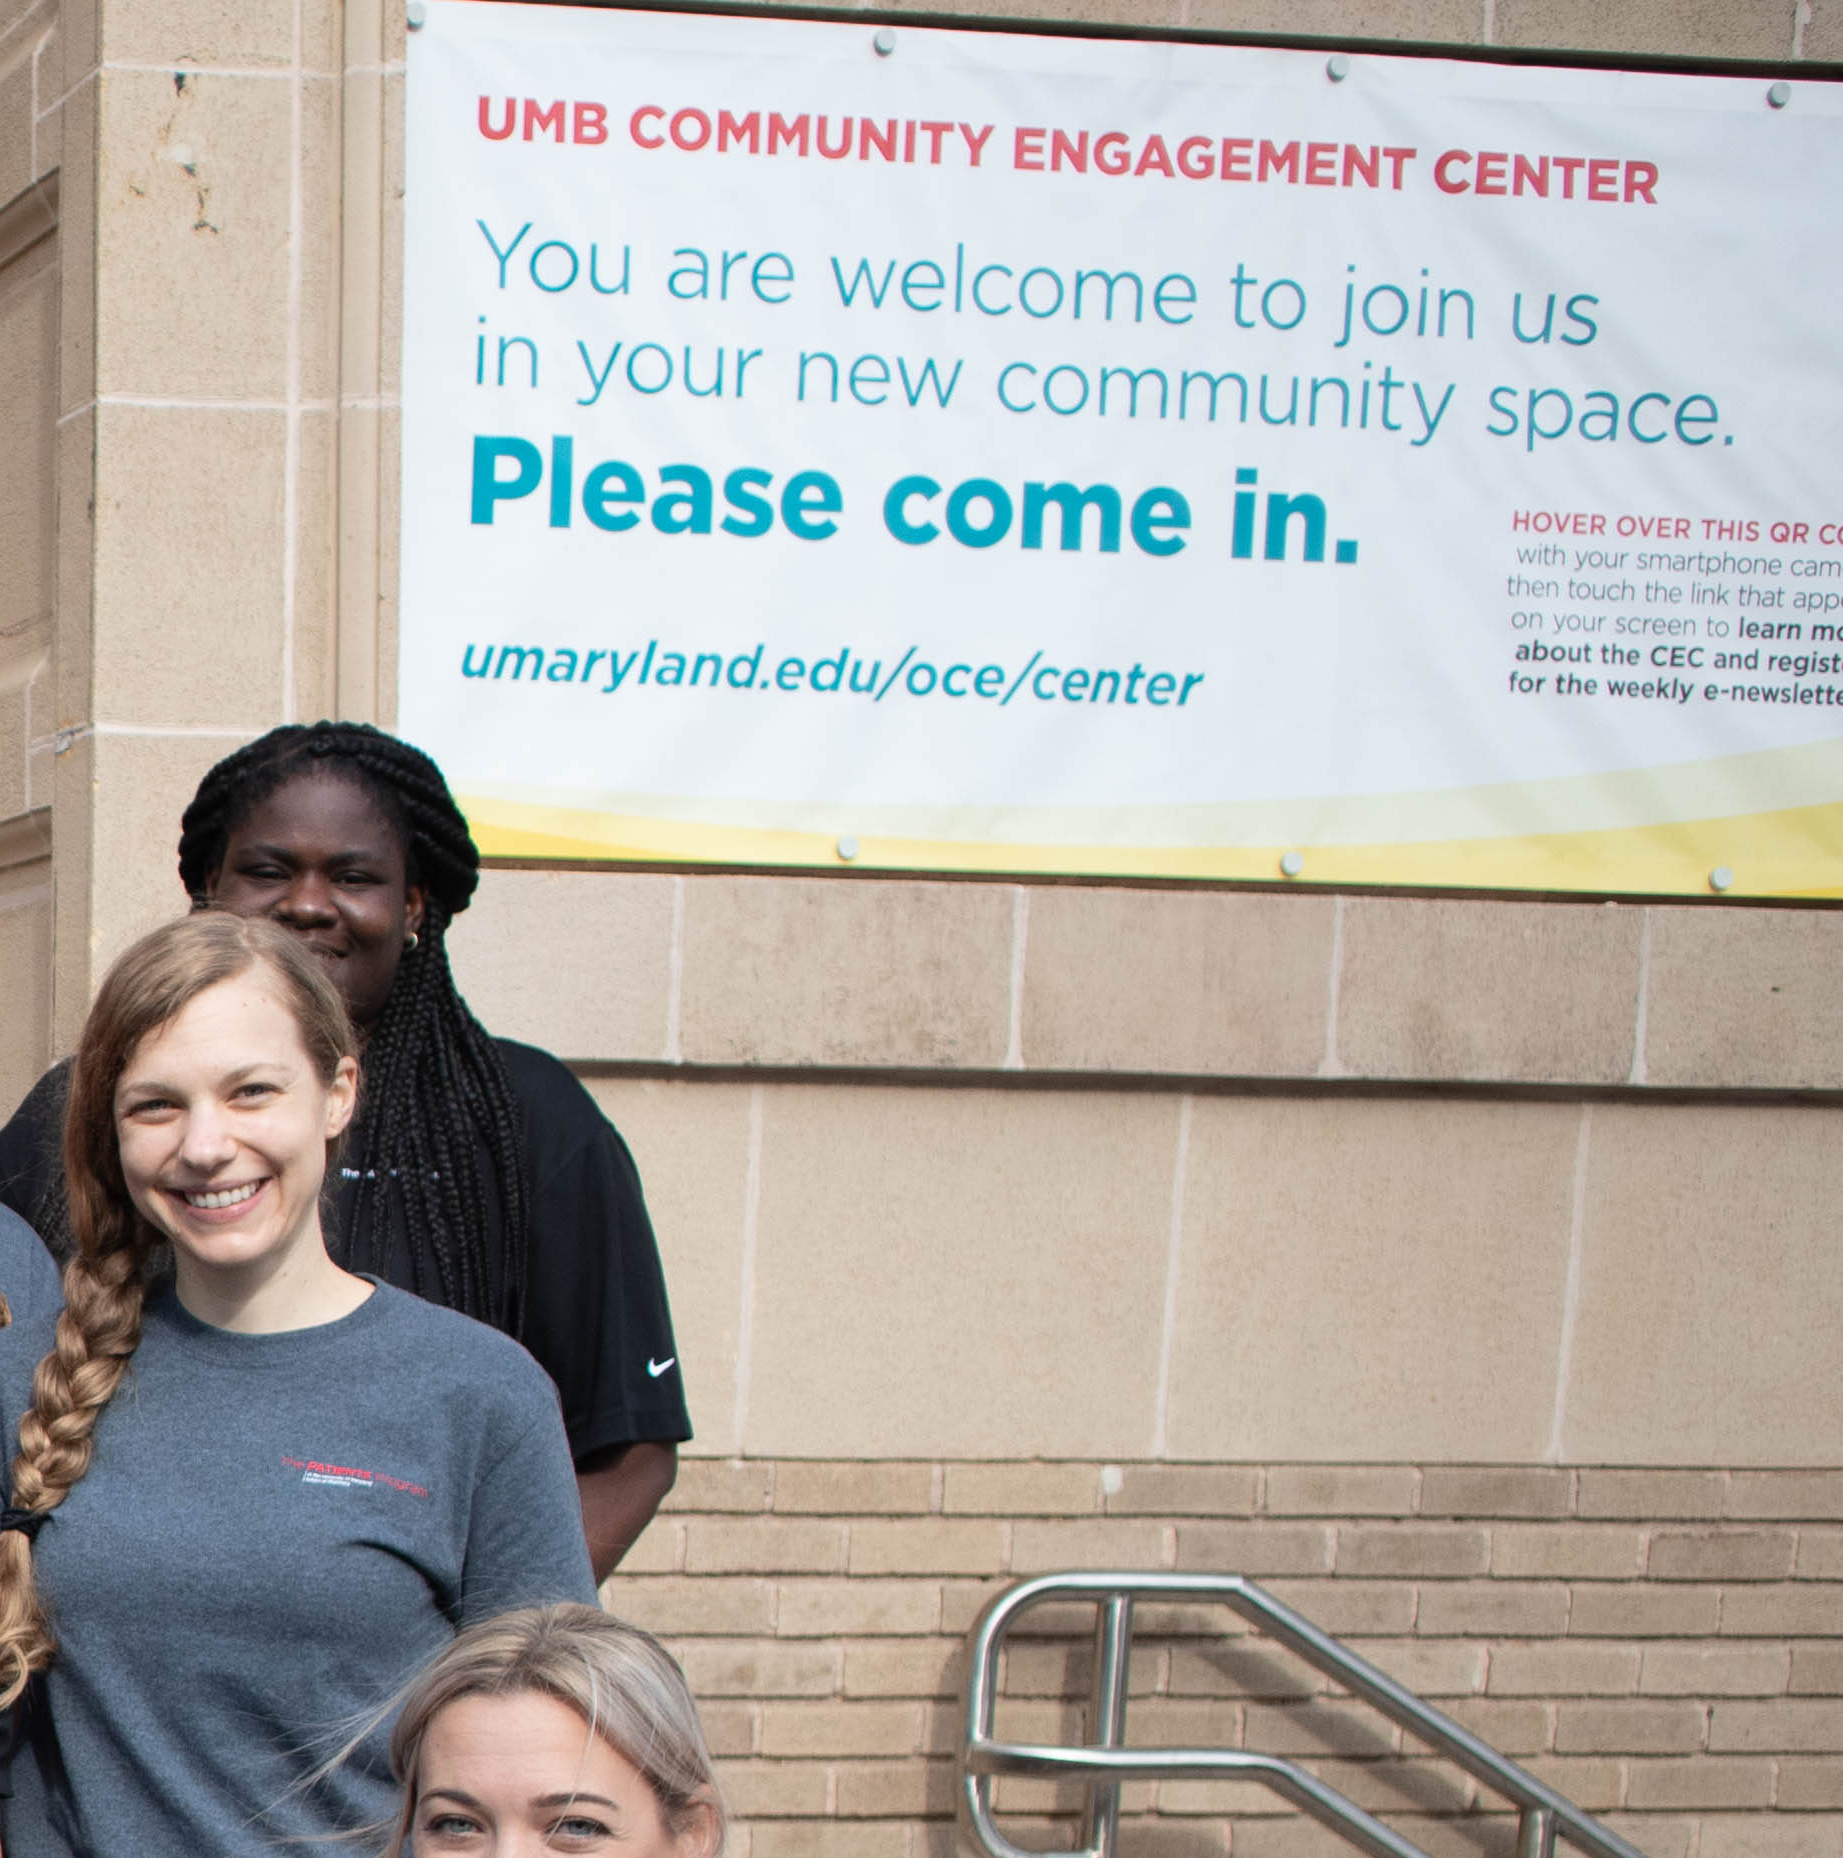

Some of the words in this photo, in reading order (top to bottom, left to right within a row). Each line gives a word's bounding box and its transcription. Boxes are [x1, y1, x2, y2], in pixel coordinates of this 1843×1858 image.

[478, 96, 608, 144] UMB
[630, 106, 994, 166] COMMUNITY
[1014, 128, 1416, 190] ENGAGEMENT
[1434, 150, 1658, 204] CENTER
[477, 220, 630, 294] You
[668, 248, 794, 304] are
[831, 243, 1197, 325] welcome
[1230, 263, 1306, 330] to
[1334, 265, 1474, 348] join
[1513, 293, 1599, 346] us
[477, 316, 538, 387] in
[578, 341, 762, 406] your
[798, 352, 963, 408] new
[998, 360, 1456, 446] community
[1487, 386, 1733, 451] space.
[471, 434, 843, 541] Please
[883, 475, 1192, 557] come
[1231, 467, 1358, 564] in.
[1513, 512, 1606, 535] HOVER
[1616, 516, 1690, 539] OVER
[1702, 520, 1759, 542] THIS
[1770, 522, 1809, 543] QR
[1517, 544, 1567, 566] with
[1575, 551, 1629, 571] your
[1638, 552, 1782, 576] smartphone
[1506, 575, 1559, 598] then
[1568, 579, 1636, 601] touch
[1645, 581, 1682, 604] the
[1691, 582, 1730, 605] link
[1738, 584, 1785, 608] that
[1793, 592, 1843, 613] app
[1511, 612, 1543, 629] on
[1554, 614, 1606, 634] your
[1616, 616, 1698, 636] screen
[1706, 616, 1730, 638] to
[1738, 617, 1802, 640] learn
[462, 640, 1205, 706] umaryland.edu/oce/center
[1515, 640, 1591, 663] about
[1601, 644, 1640, 666] the
[1650, 646, 1703, 668] CEC
[1714, 649, 1759, 670] and
[1768, 652, 1843, 677] regist
[1509, 671, 1546, 693] for
[1556, 674, 1597, 695] the
[1608, 678, 1694, 704] weekly
